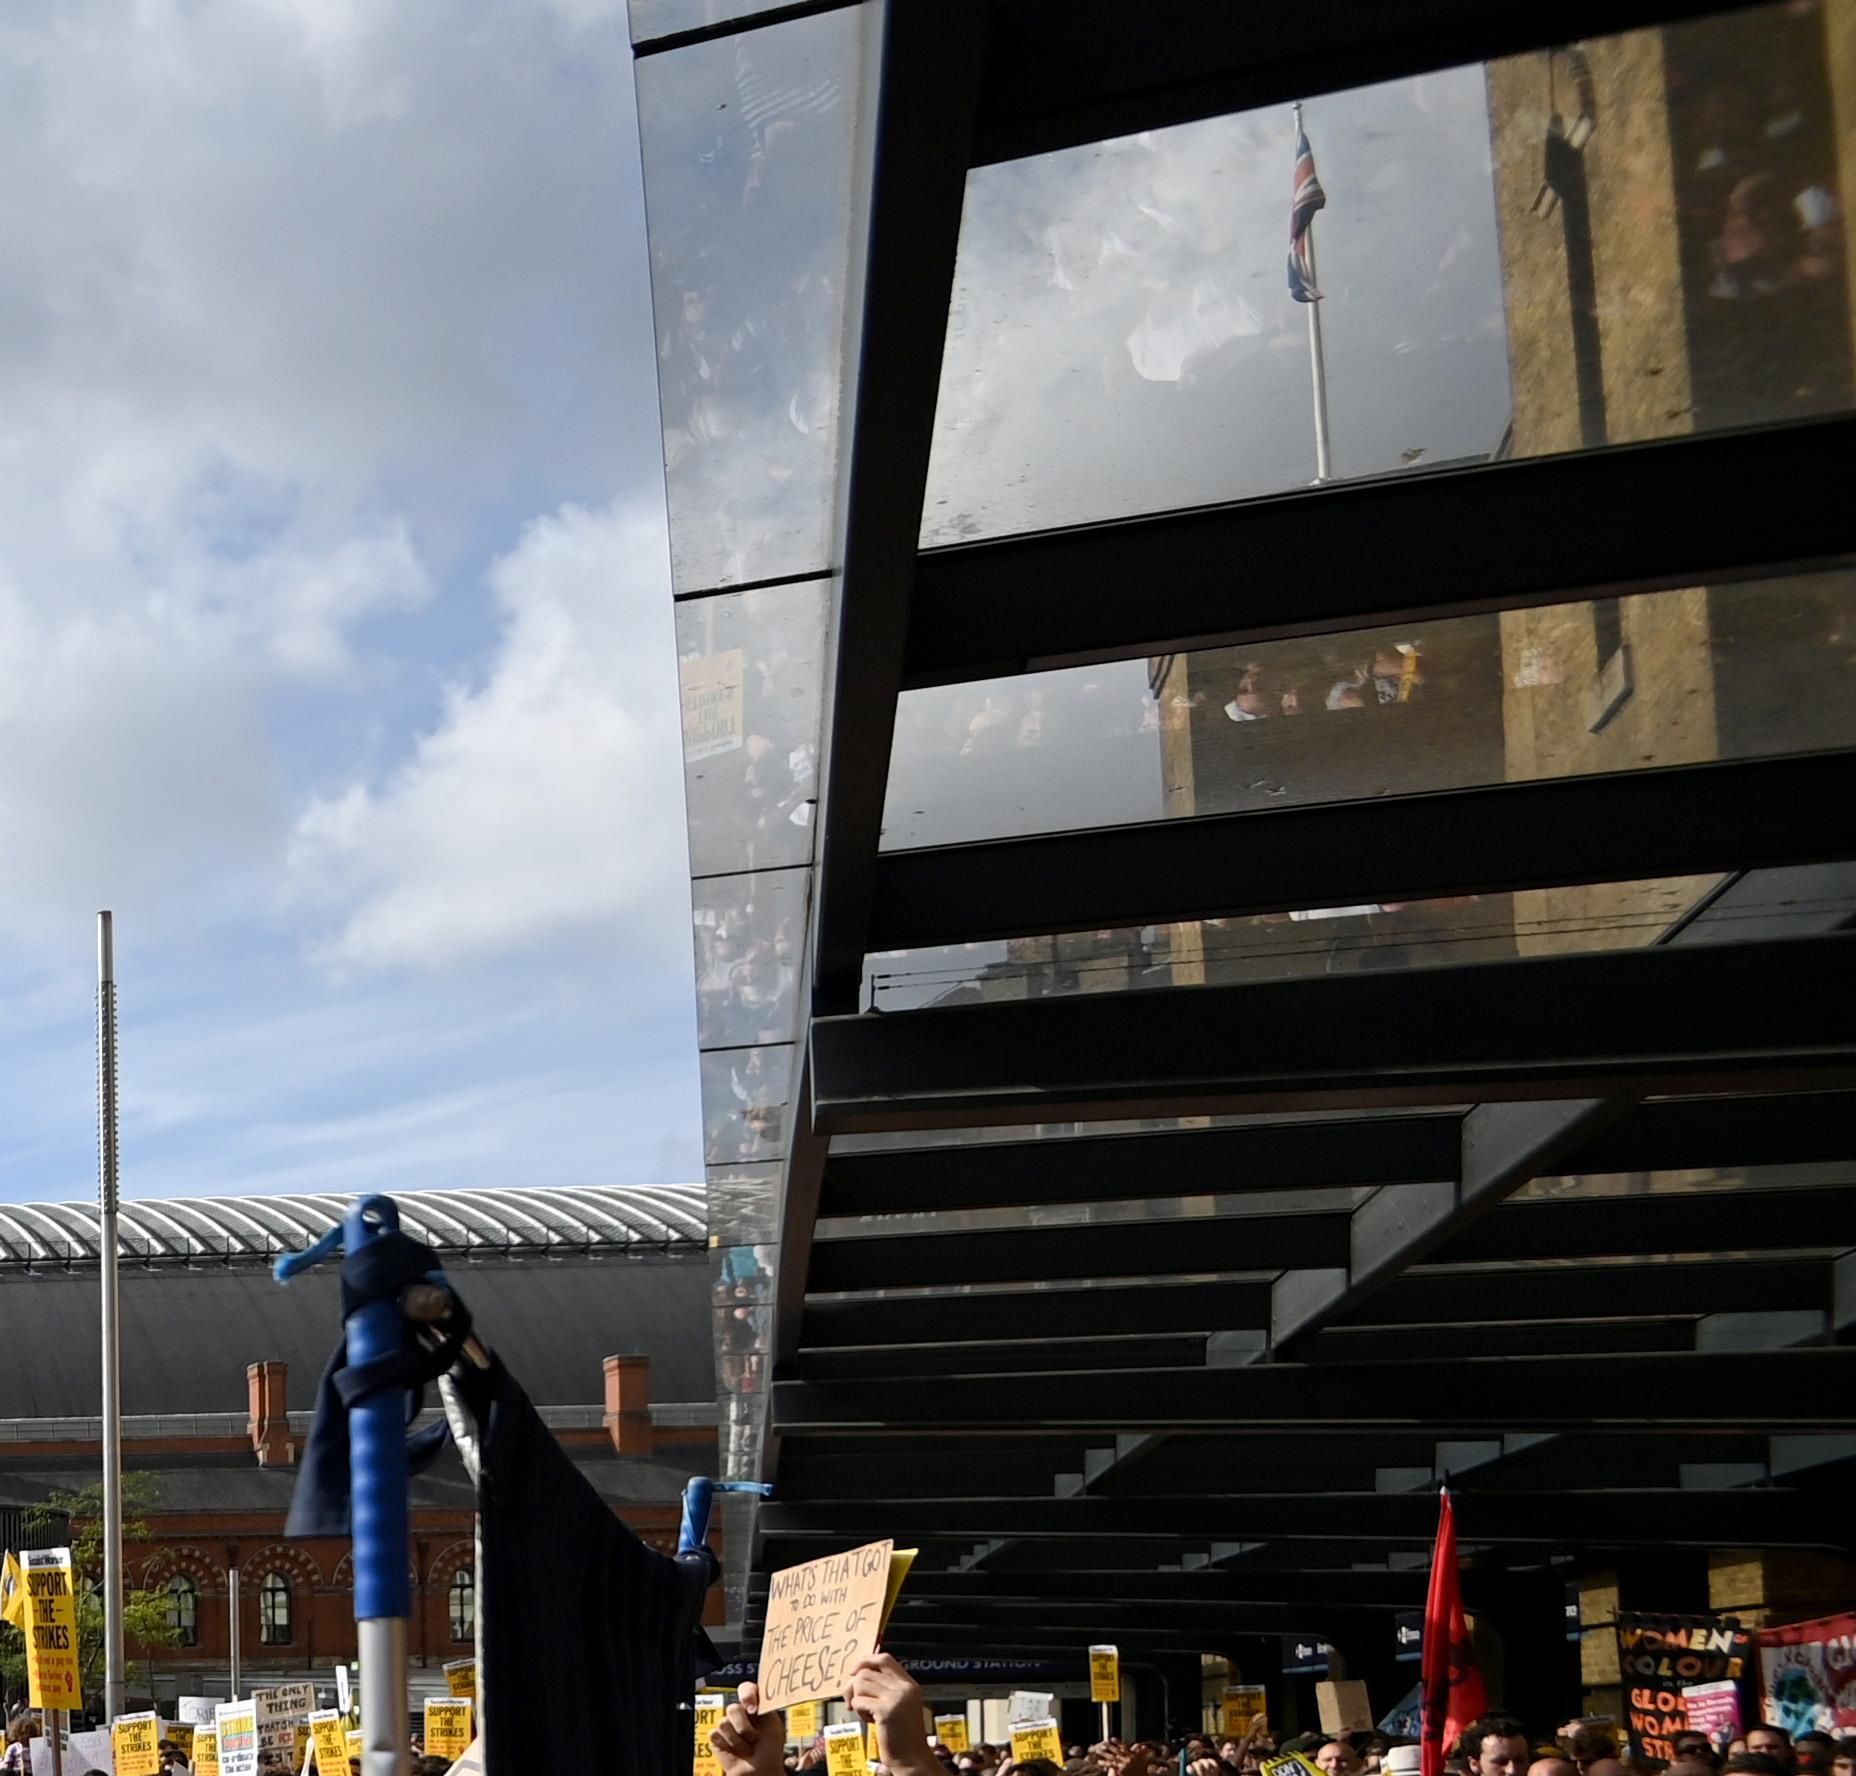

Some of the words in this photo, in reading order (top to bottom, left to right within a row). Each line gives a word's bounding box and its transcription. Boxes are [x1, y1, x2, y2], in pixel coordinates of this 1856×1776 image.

[823, 1551, 861, 1584] THAT
[862, 1541, 892, 1578] GOT
[27, 1571, 69, 1597] SUPPORT
[820, 1587, 848, 1605] WITH
[38, 1599, 56, 1624] THE
[767, 1624, 792, 1655] THE
[792, 1612, 841, 1647] PRICE
[845, 1601, 878, 1634] OF
[33, 1624, 70, 1651] STRIKES
[1619, 1627, 1735, 1654] WOMEN
[764, 1638, 859, 1701] CHEESE?
[256, 1691, 278, 1703] THE
[281, 1684, 310, 1697] ONLY
[265, 1698, 306, 1715] THING
[428, 1706, 466, 1717] SUPPORT
[118, 1719, 152, 1734] SUPPORT
[313, 1720, 338, 1735] SUPPORT
[439, 1716, 454, 1727] THE
[128, 1732, 142, 1744] THE
[430, 1727, 465, 1738] STRIKES
[1014, 1728, 1054, 1743] SUPPORT
[121, 1741, 152, 1755] STRIKES
[319, 1745, 343, 1760] STRIKES
[829, 1736, 861, 1754] SUPPORT
[1027, 1741, 1043, 1751] THE
[1641, 1736, 1676, 1760] STR
[839, 1754, 852, 1769] THE
[1019, 1749, 1056, 1761] STRIKES
